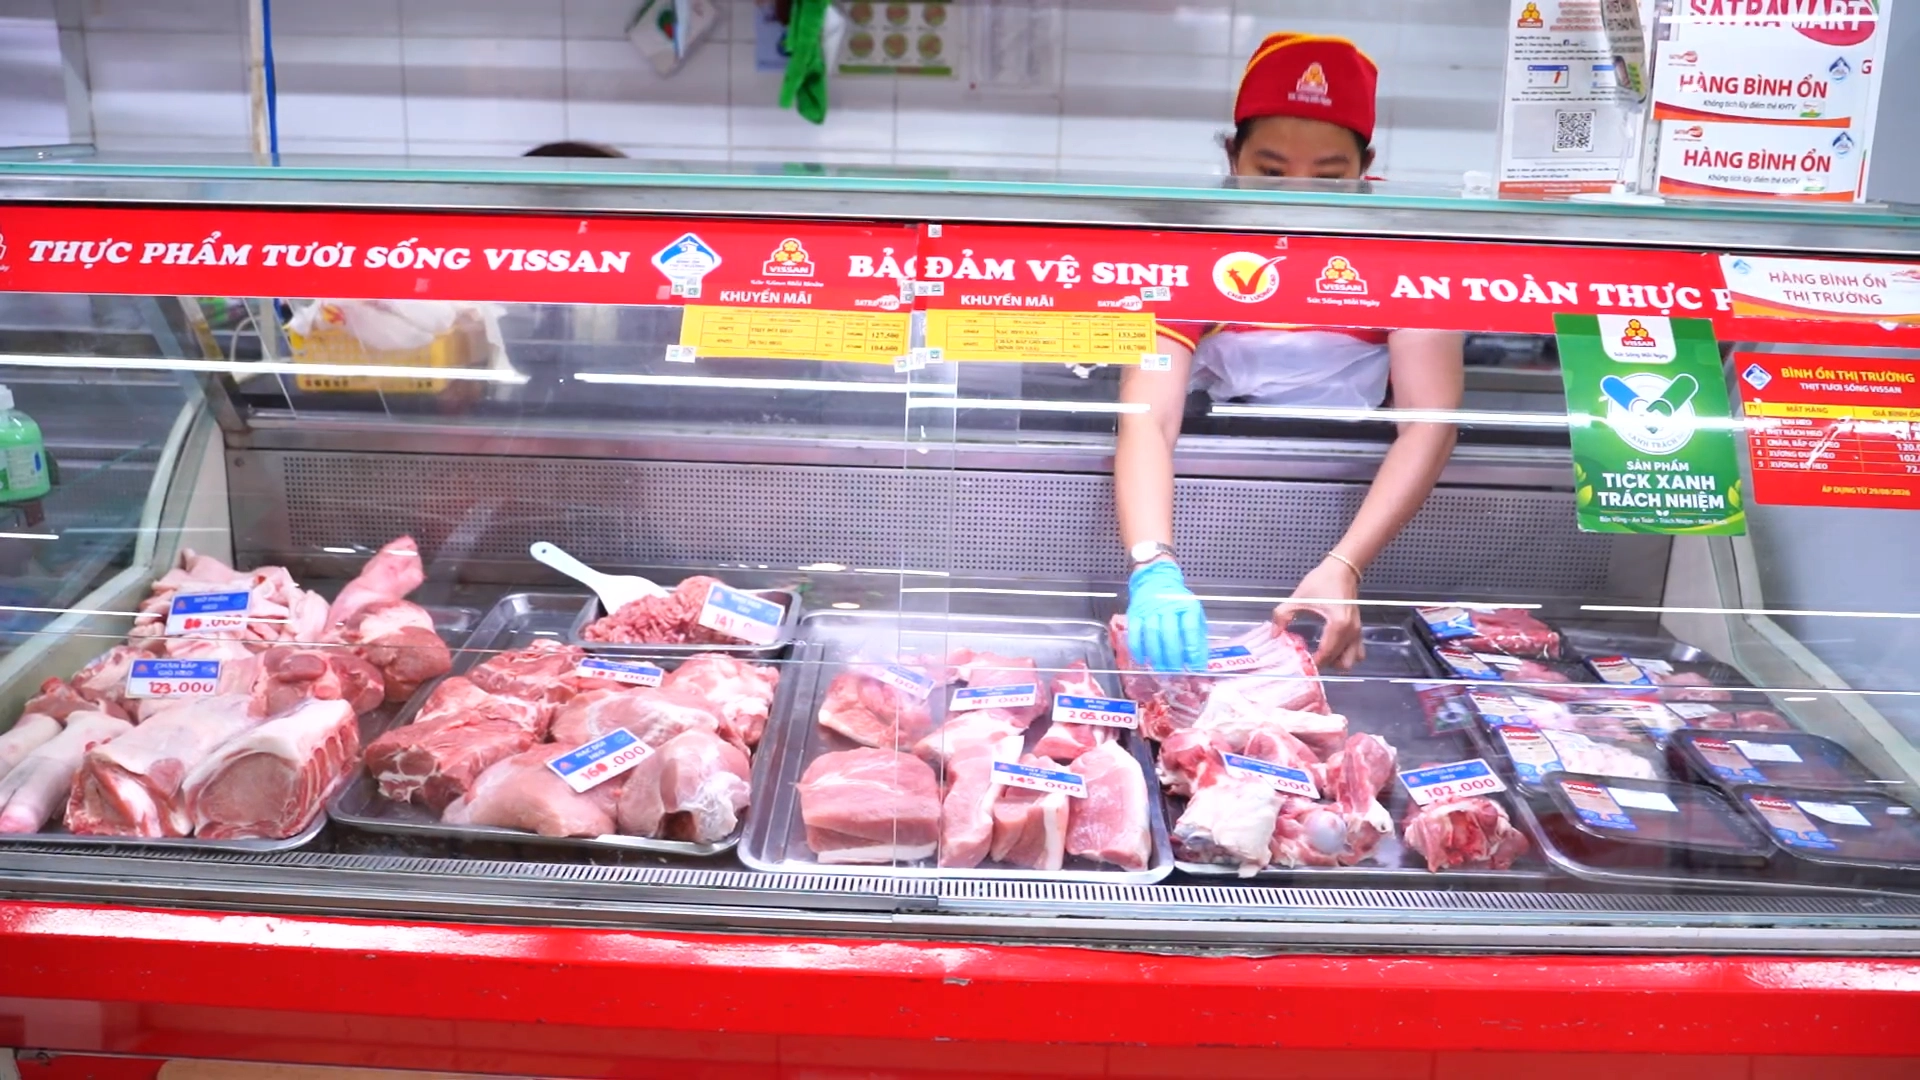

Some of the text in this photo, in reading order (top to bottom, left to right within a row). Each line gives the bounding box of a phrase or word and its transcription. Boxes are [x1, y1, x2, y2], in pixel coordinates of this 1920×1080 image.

[1680, 72, 1828, 98] HÀNG BÌNH ỔN
[1683, 147, 1831, 172] HÀNG BÌNH ỔN
[29, 231, 631, 273] THỰC PHẨM TƯƠI SỐNG VISSAN
[769, 265, 810, 275] VISSAN
[925, 249, 1016, 282] ĐẢM
[1027, 255, 1081, 289] VỆ
[1091, 262, 1190, 287] SINH
[1769, 271, 1816, 285] HÀNG
[1820, 273, 1859, 287] BÌNH
[1322, 283, 1362, 292] VISSAN
[1390, 275, 1451, 300] AN
[1461, 274, 1578, 306] TOÀN
[1589, 282, 1703, 315] THỰC
[720, 288, 780, 304] KHUYẾN
[961, 292, 1022, 307] KHUYẾN
[1784, 290, 1882, 305] THỊ TRƯỜNG
[1623, 339, 1655, 347] VISSAN
[1781, 366, 1813, 379] BÌNH
[1836, 369, 1859, 383] THỊ
[1861, 371, 1915, 384] TRƯỜNG
[1870, 385, 1902, 394] VISSAN
[1626, 459, 1651, 471] SẢN
[1602, 473, 1715, 490] TICK XANH
[1597, 489, 1725, 512] TRÁCH NHIỆM
[1424, 778, 1496, 798] 102.000
